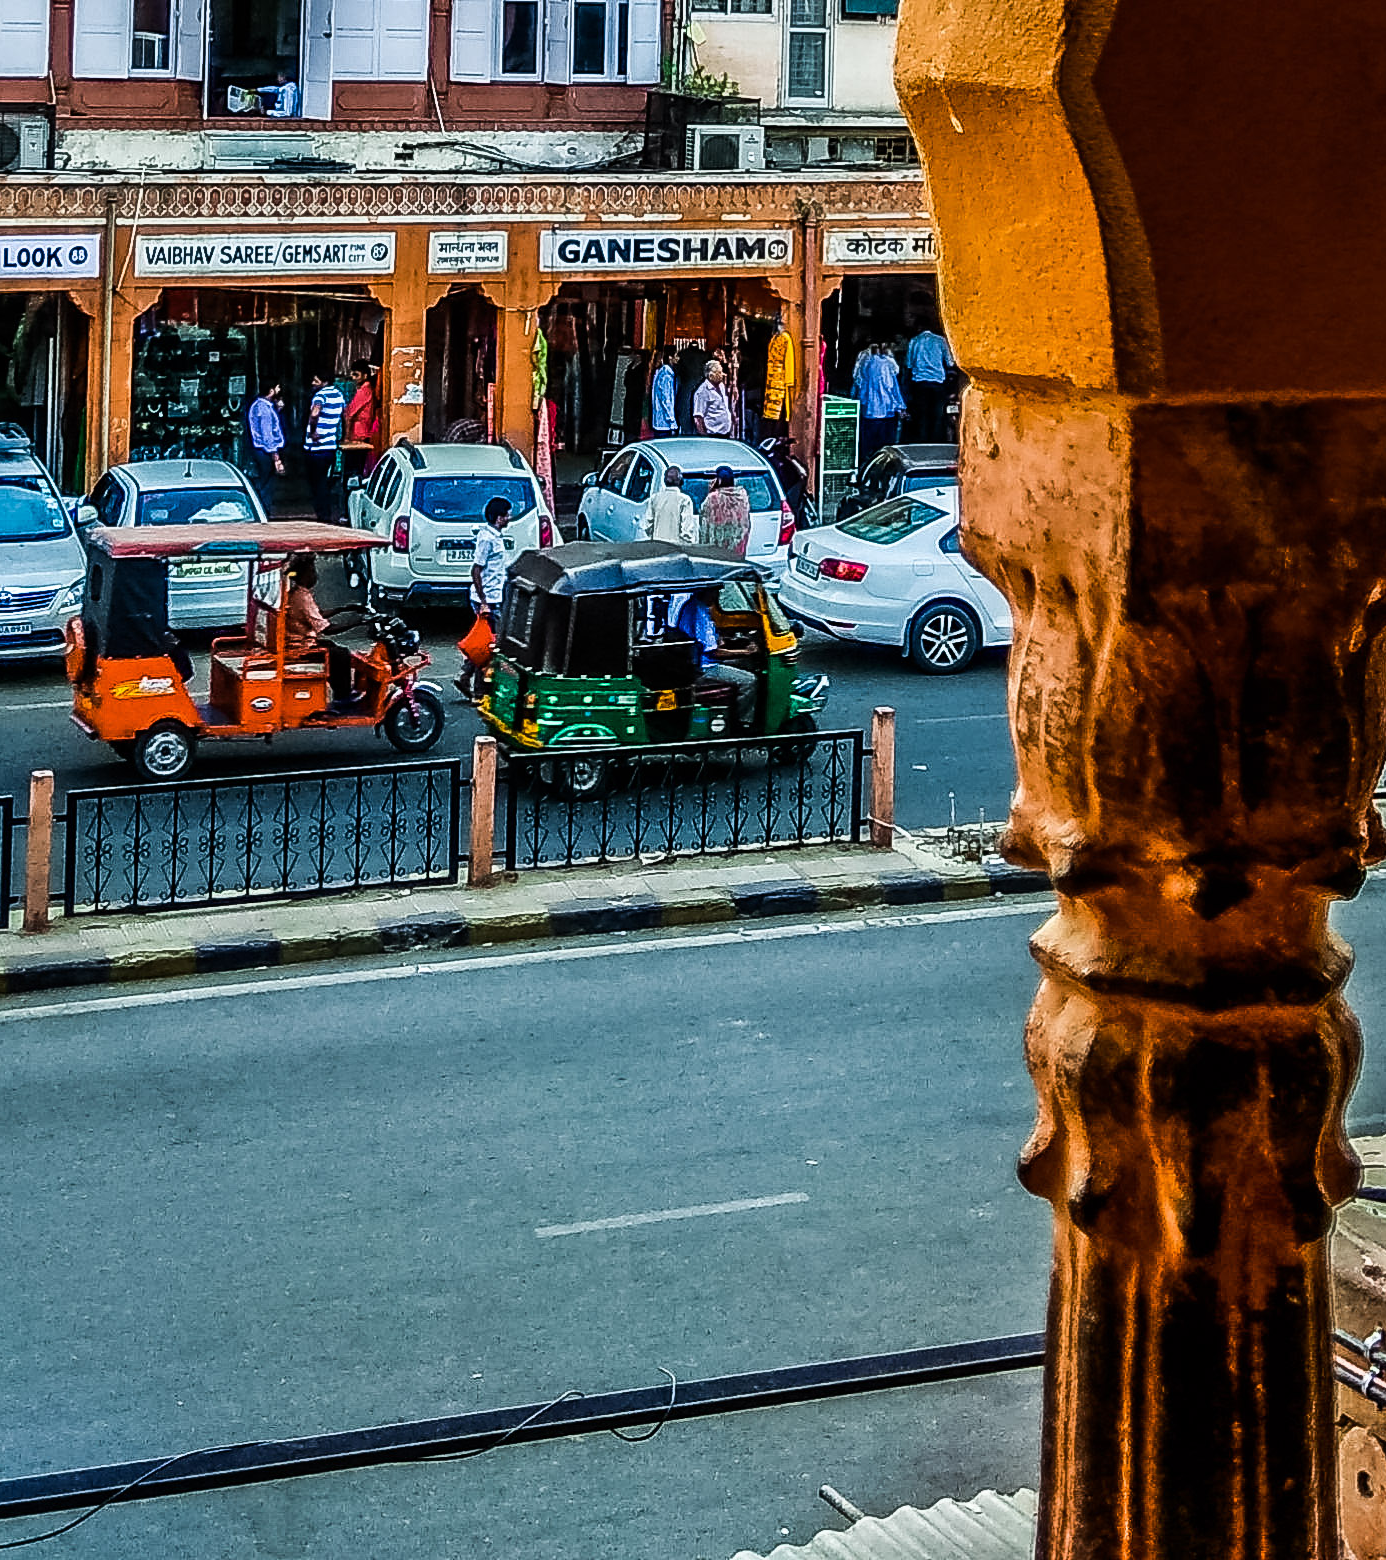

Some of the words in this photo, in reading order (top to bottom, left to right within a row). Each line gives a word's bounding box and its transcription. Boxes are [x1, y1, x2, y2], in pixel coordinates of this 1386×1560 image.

[372, 244, 388, 260] 89
[558, 237, 766, 263] GANESHAM
[769, 241, 786, 258] 90
[845, 232, 907, 255] कोटक
[3, 246, 63, 268] LOOK
[145, 246, 215, 265] VAIBHAV
